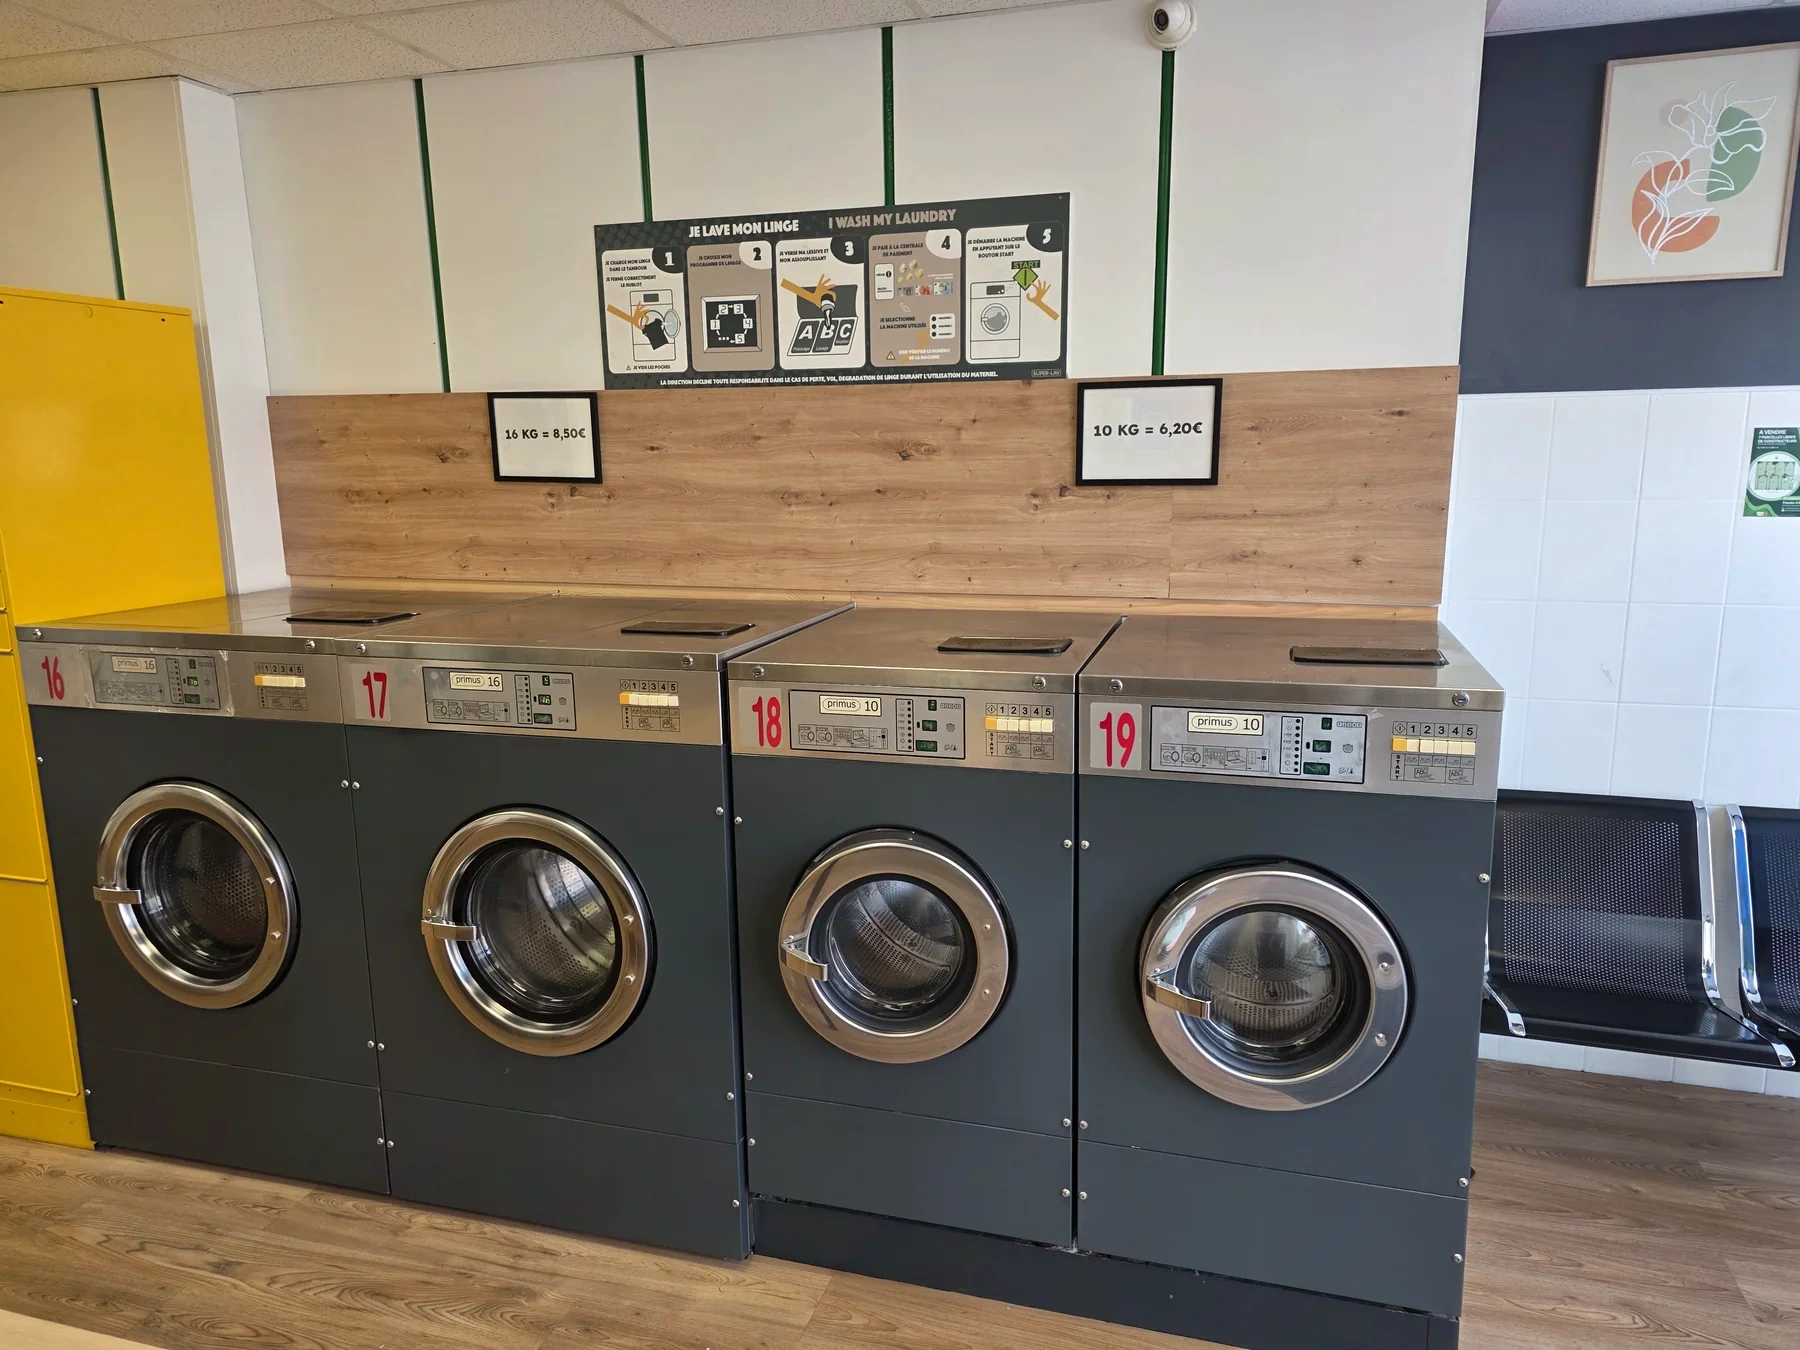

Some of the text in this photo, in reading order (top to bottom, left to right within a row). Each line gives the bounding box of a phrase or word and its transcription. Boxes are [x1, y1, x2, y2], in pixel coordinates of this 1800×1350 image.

[829, 209, 956, 229] I WASH MY LAUNDRY
[689, 220, 799, 238] JE LAVE MON LINGE
[1043, 228, 1051, 244] 5
[845, 241, 854, 256] 3
[941, 235, 951, 250] 4
[665, 252, 675, 266] 1
[753, 247, 761, 261] 2
[1014, 261, 1039, 269] START
[736, 305, 741, 313] 3
[798, 325, 813, 340] A
[820, 324, 835, 339] B
[840, 323, 852, 338] C
[505, 429, 518, 439] 16
[522, 429, 538, 439] KG
[553, 428, 586, 441] 8,50€
[1094, 425, 1112, 436] 10
[1118, 424, 1139, 436] KG
[1160, 422, 1202, 437] 6,20€
[118, 660, 155, 669] primus 16
[42, 656, 65, 700] 16
[456, 674, 500, 687] primus 16
[362, 671, 387, 719] 17
[827, 700, 878, 712] primus 10
[1011, 706, 1016, 714] 2
[1022, 707, 1028, 715] 3
[1045, 708, 1051, 716] 5
[752, 696, 782, 748] 18
[1198, 716, 1260, 730] primus 10
[1411, 725, 1473, 736] 1 2 3 4 5
[1099, 712, 1136, 768] 19
